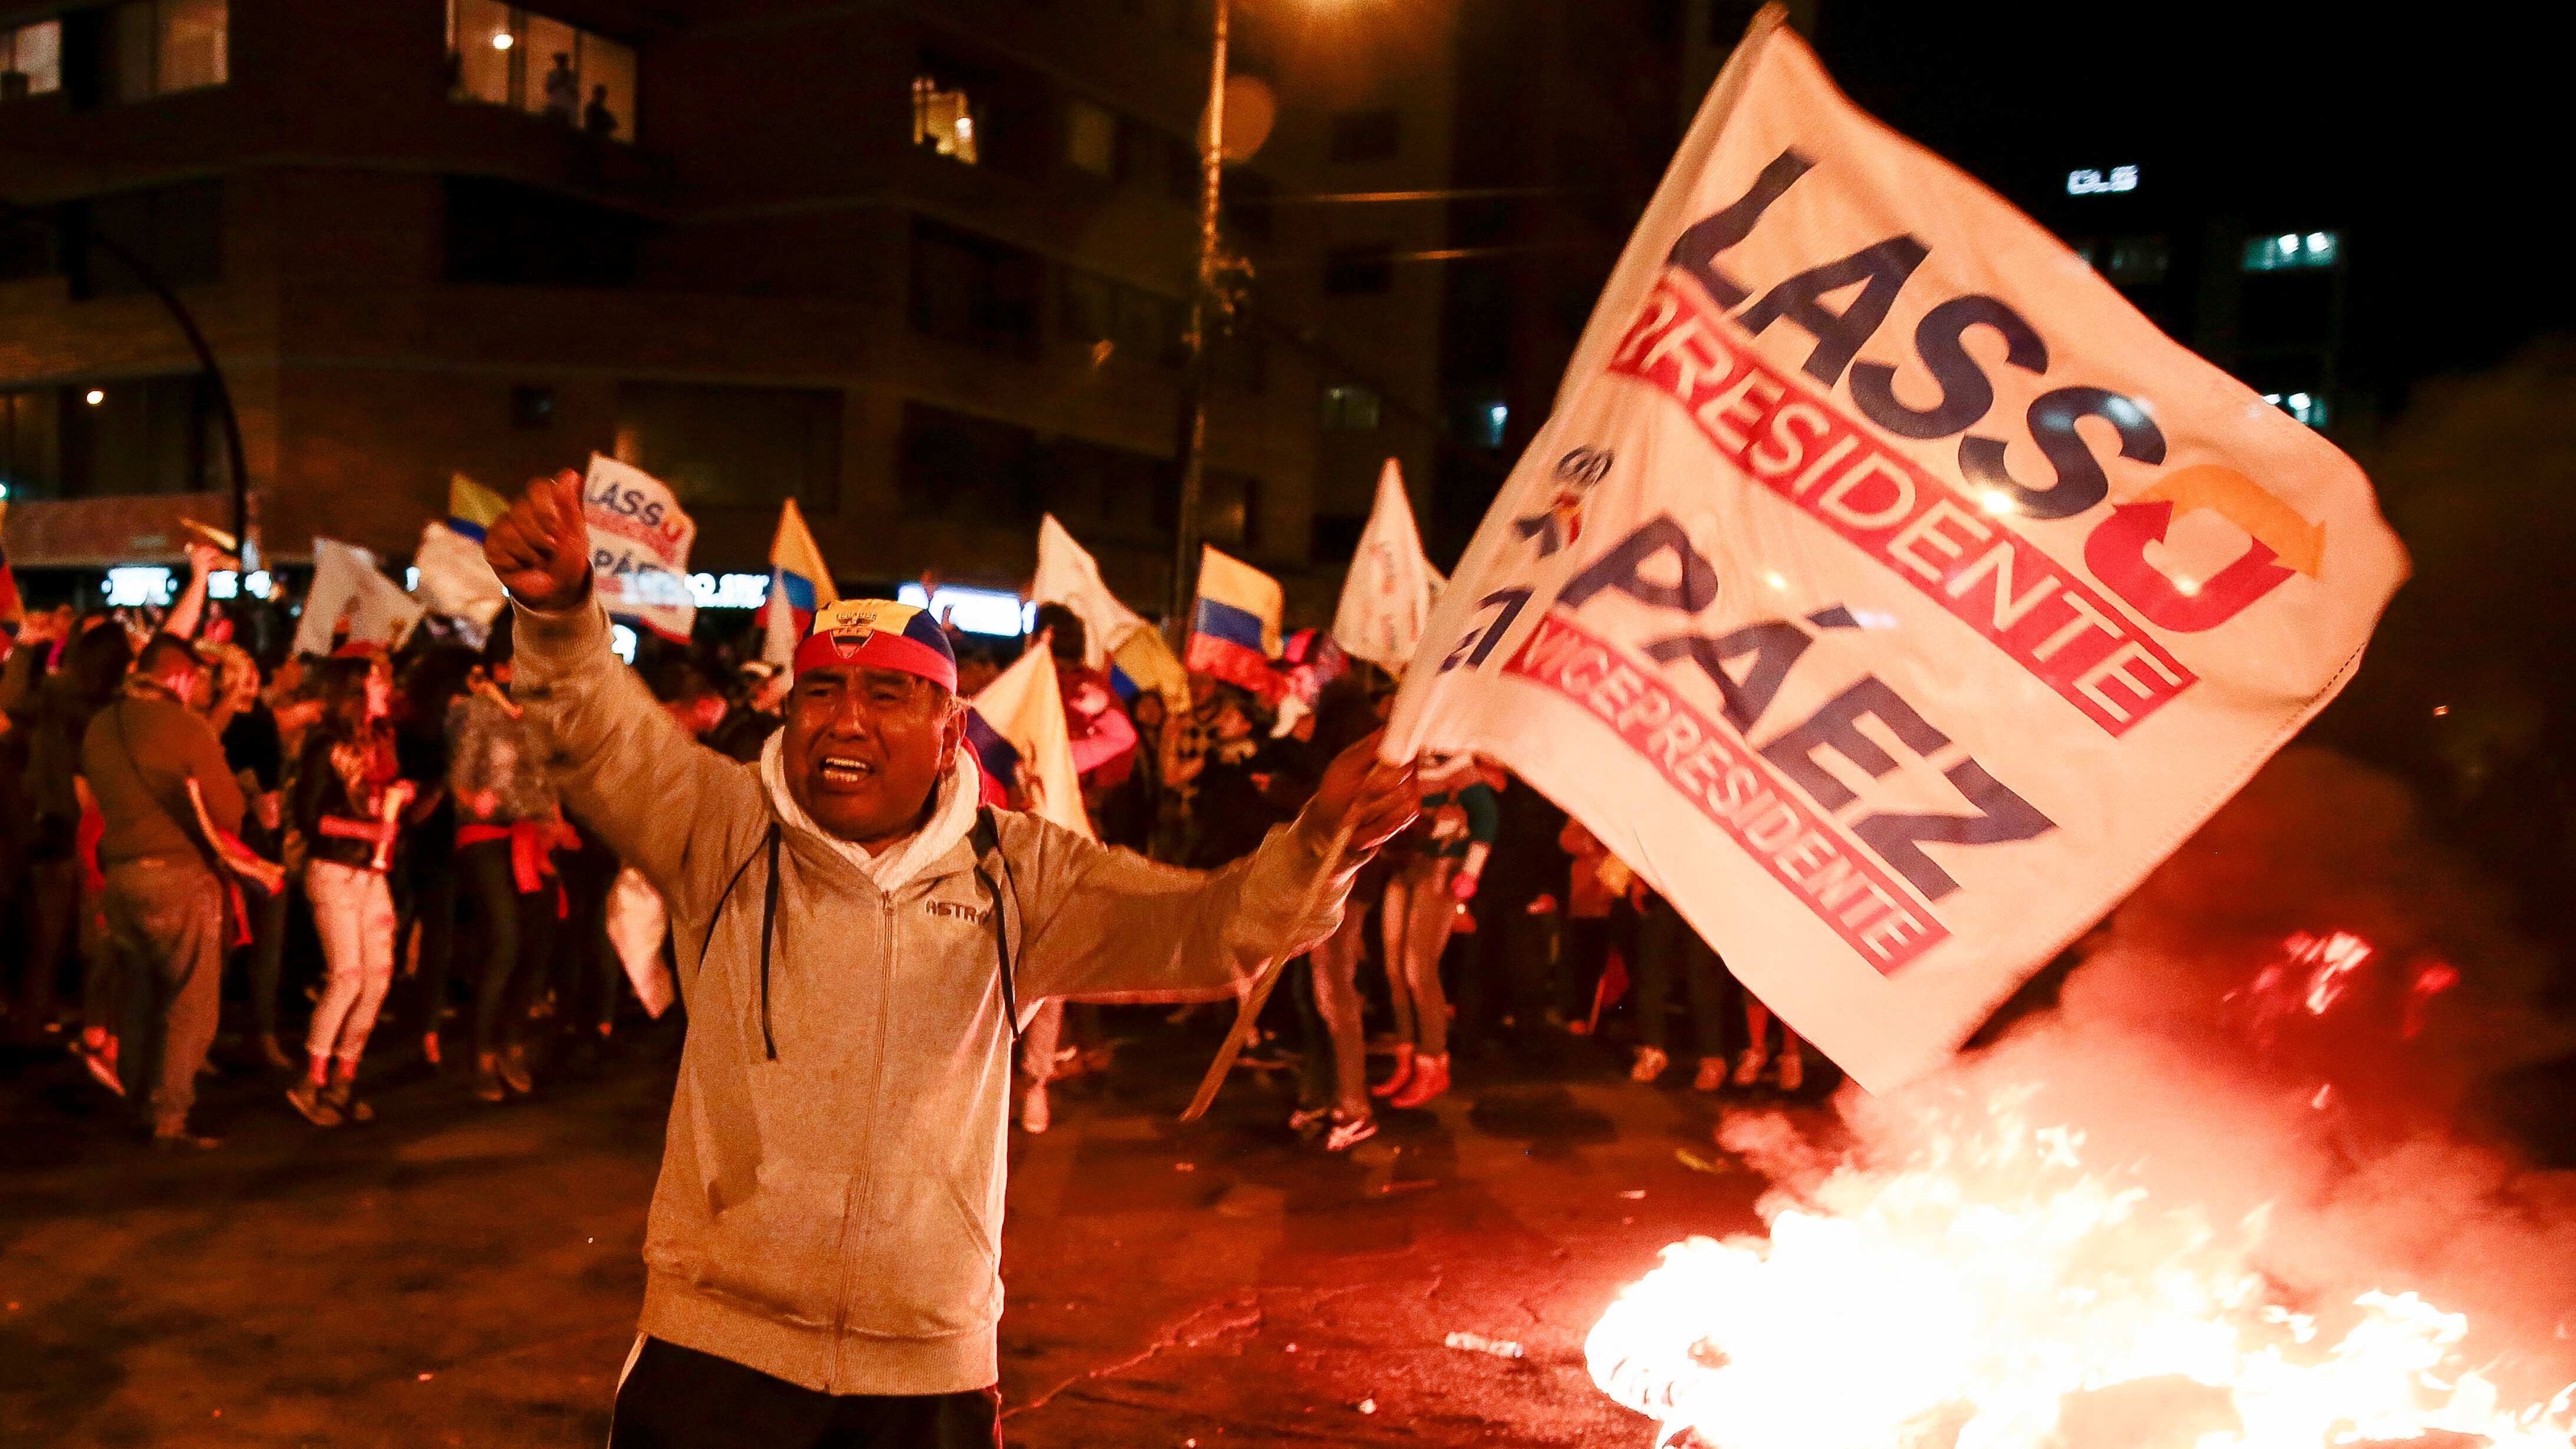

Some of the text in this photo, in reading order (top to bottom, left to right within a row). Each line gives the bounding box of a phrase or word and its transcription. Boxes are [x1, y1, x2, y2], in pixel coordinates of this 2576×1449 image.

[1618, 292, 2182, 722] PRESIDENTE
[1667, 145, 2326, 633] LASSO
[1521, 619, 1928, 962] VICEPRESIDENTE
[1555, 514, 2061, 904] PÁEZ
